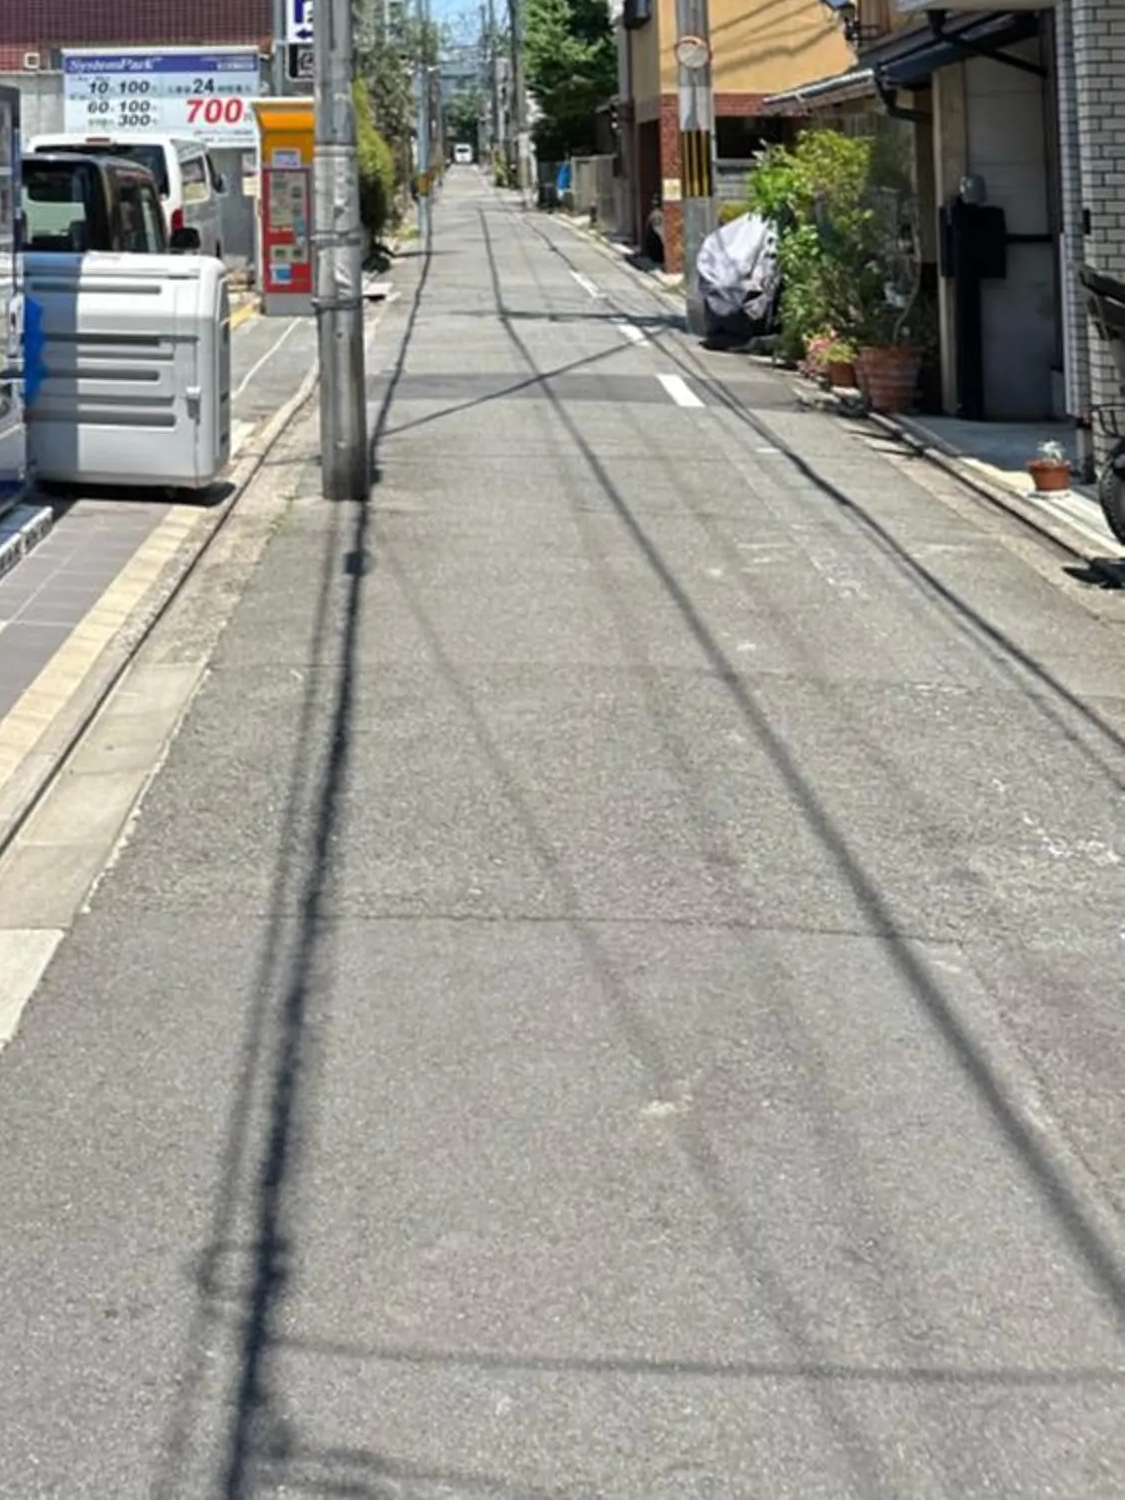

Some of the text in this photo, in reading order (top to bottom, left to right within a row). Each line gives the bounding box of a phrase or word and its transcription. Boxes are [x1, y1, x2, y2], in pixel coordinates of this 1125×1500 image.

[120, 81, 150, 95] 100
[193, 77, 215, 95] 24
[120, 100, 150, 113] 100
[186, 99, 243, 124] 700
